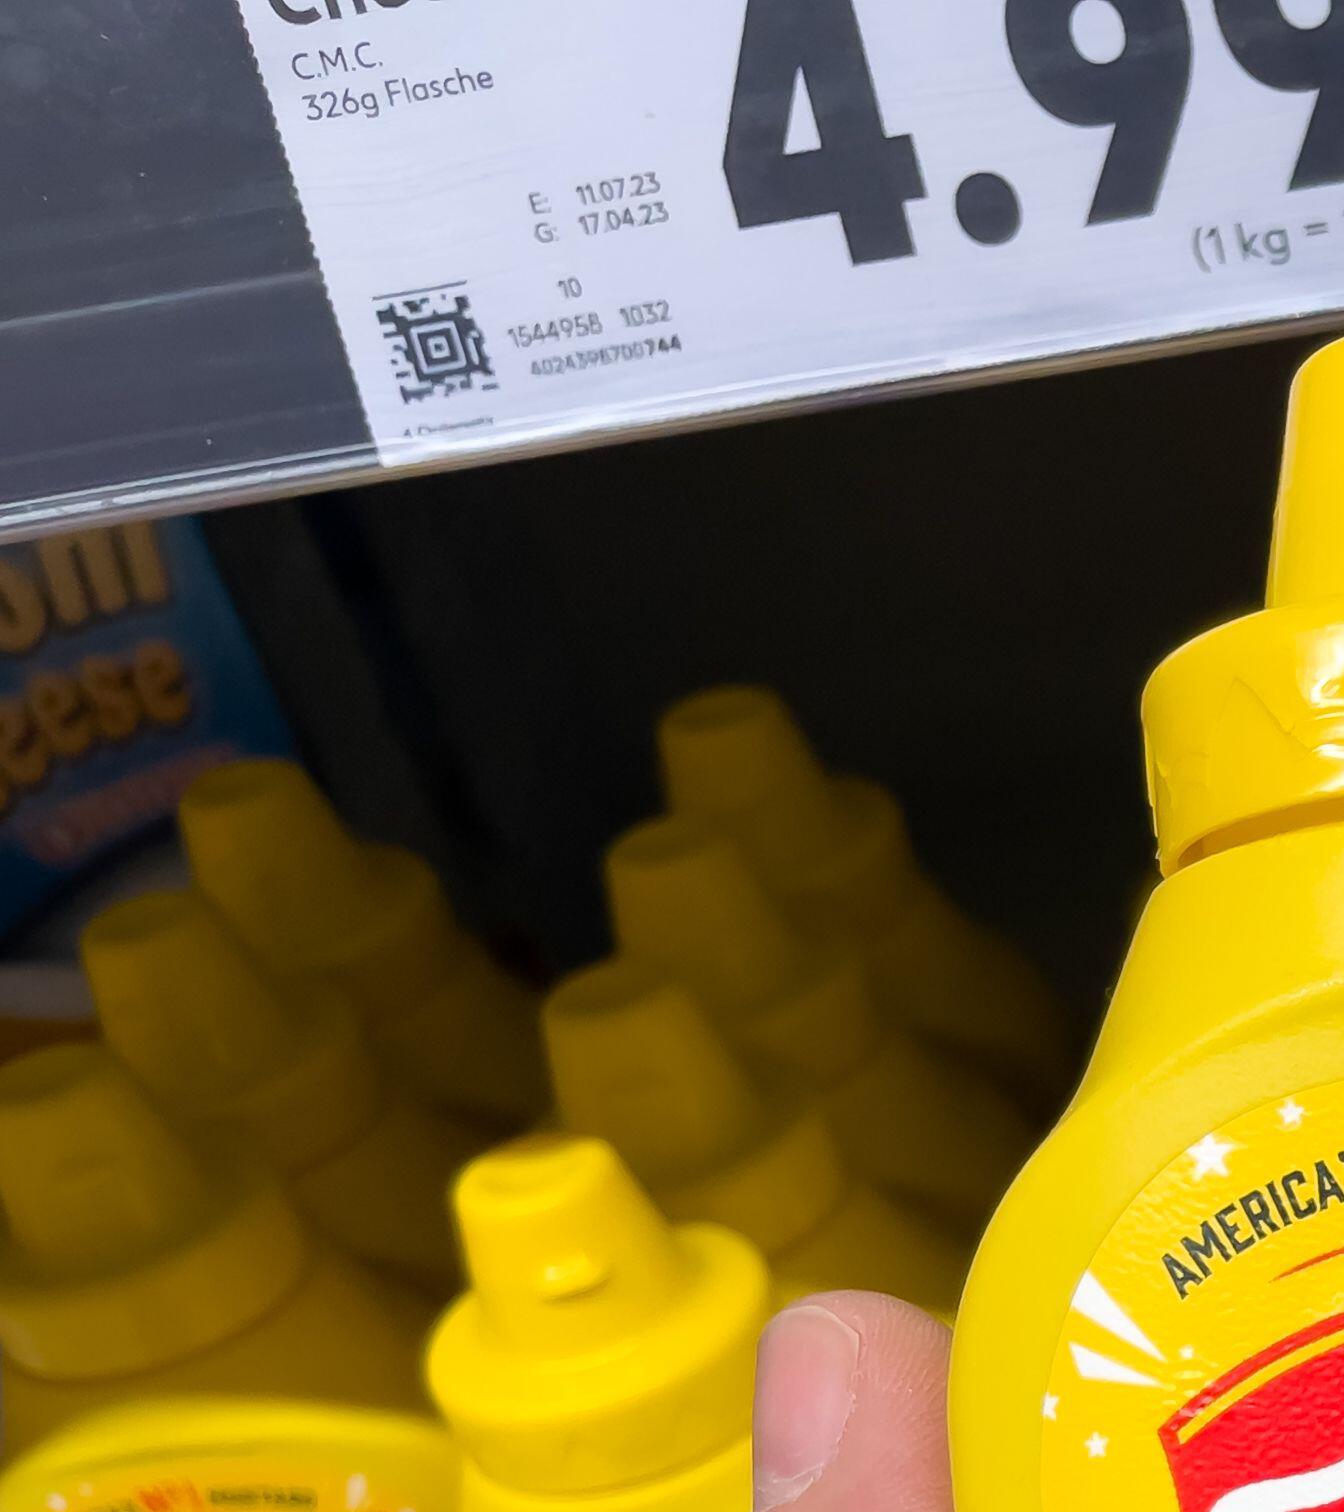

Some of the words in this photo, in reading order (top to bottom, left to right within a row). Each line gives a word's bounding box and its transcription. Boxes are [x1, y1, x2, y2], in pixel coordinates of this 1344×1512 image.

[291, 41, 384, 80] C.M.C.
[301, 87, 380, 121] 326g
[384, 67, 495, 107] Flasche
[576, 171, 661, 207] 11.07.23
[578, 201, 670, 236] 17.04.23
[1239, 211, 1291, 268] kg
[557, 276, 584, 300] 10
[507, 311, 604, 349] 1544958
[619, 299, 673, 328] 1032
